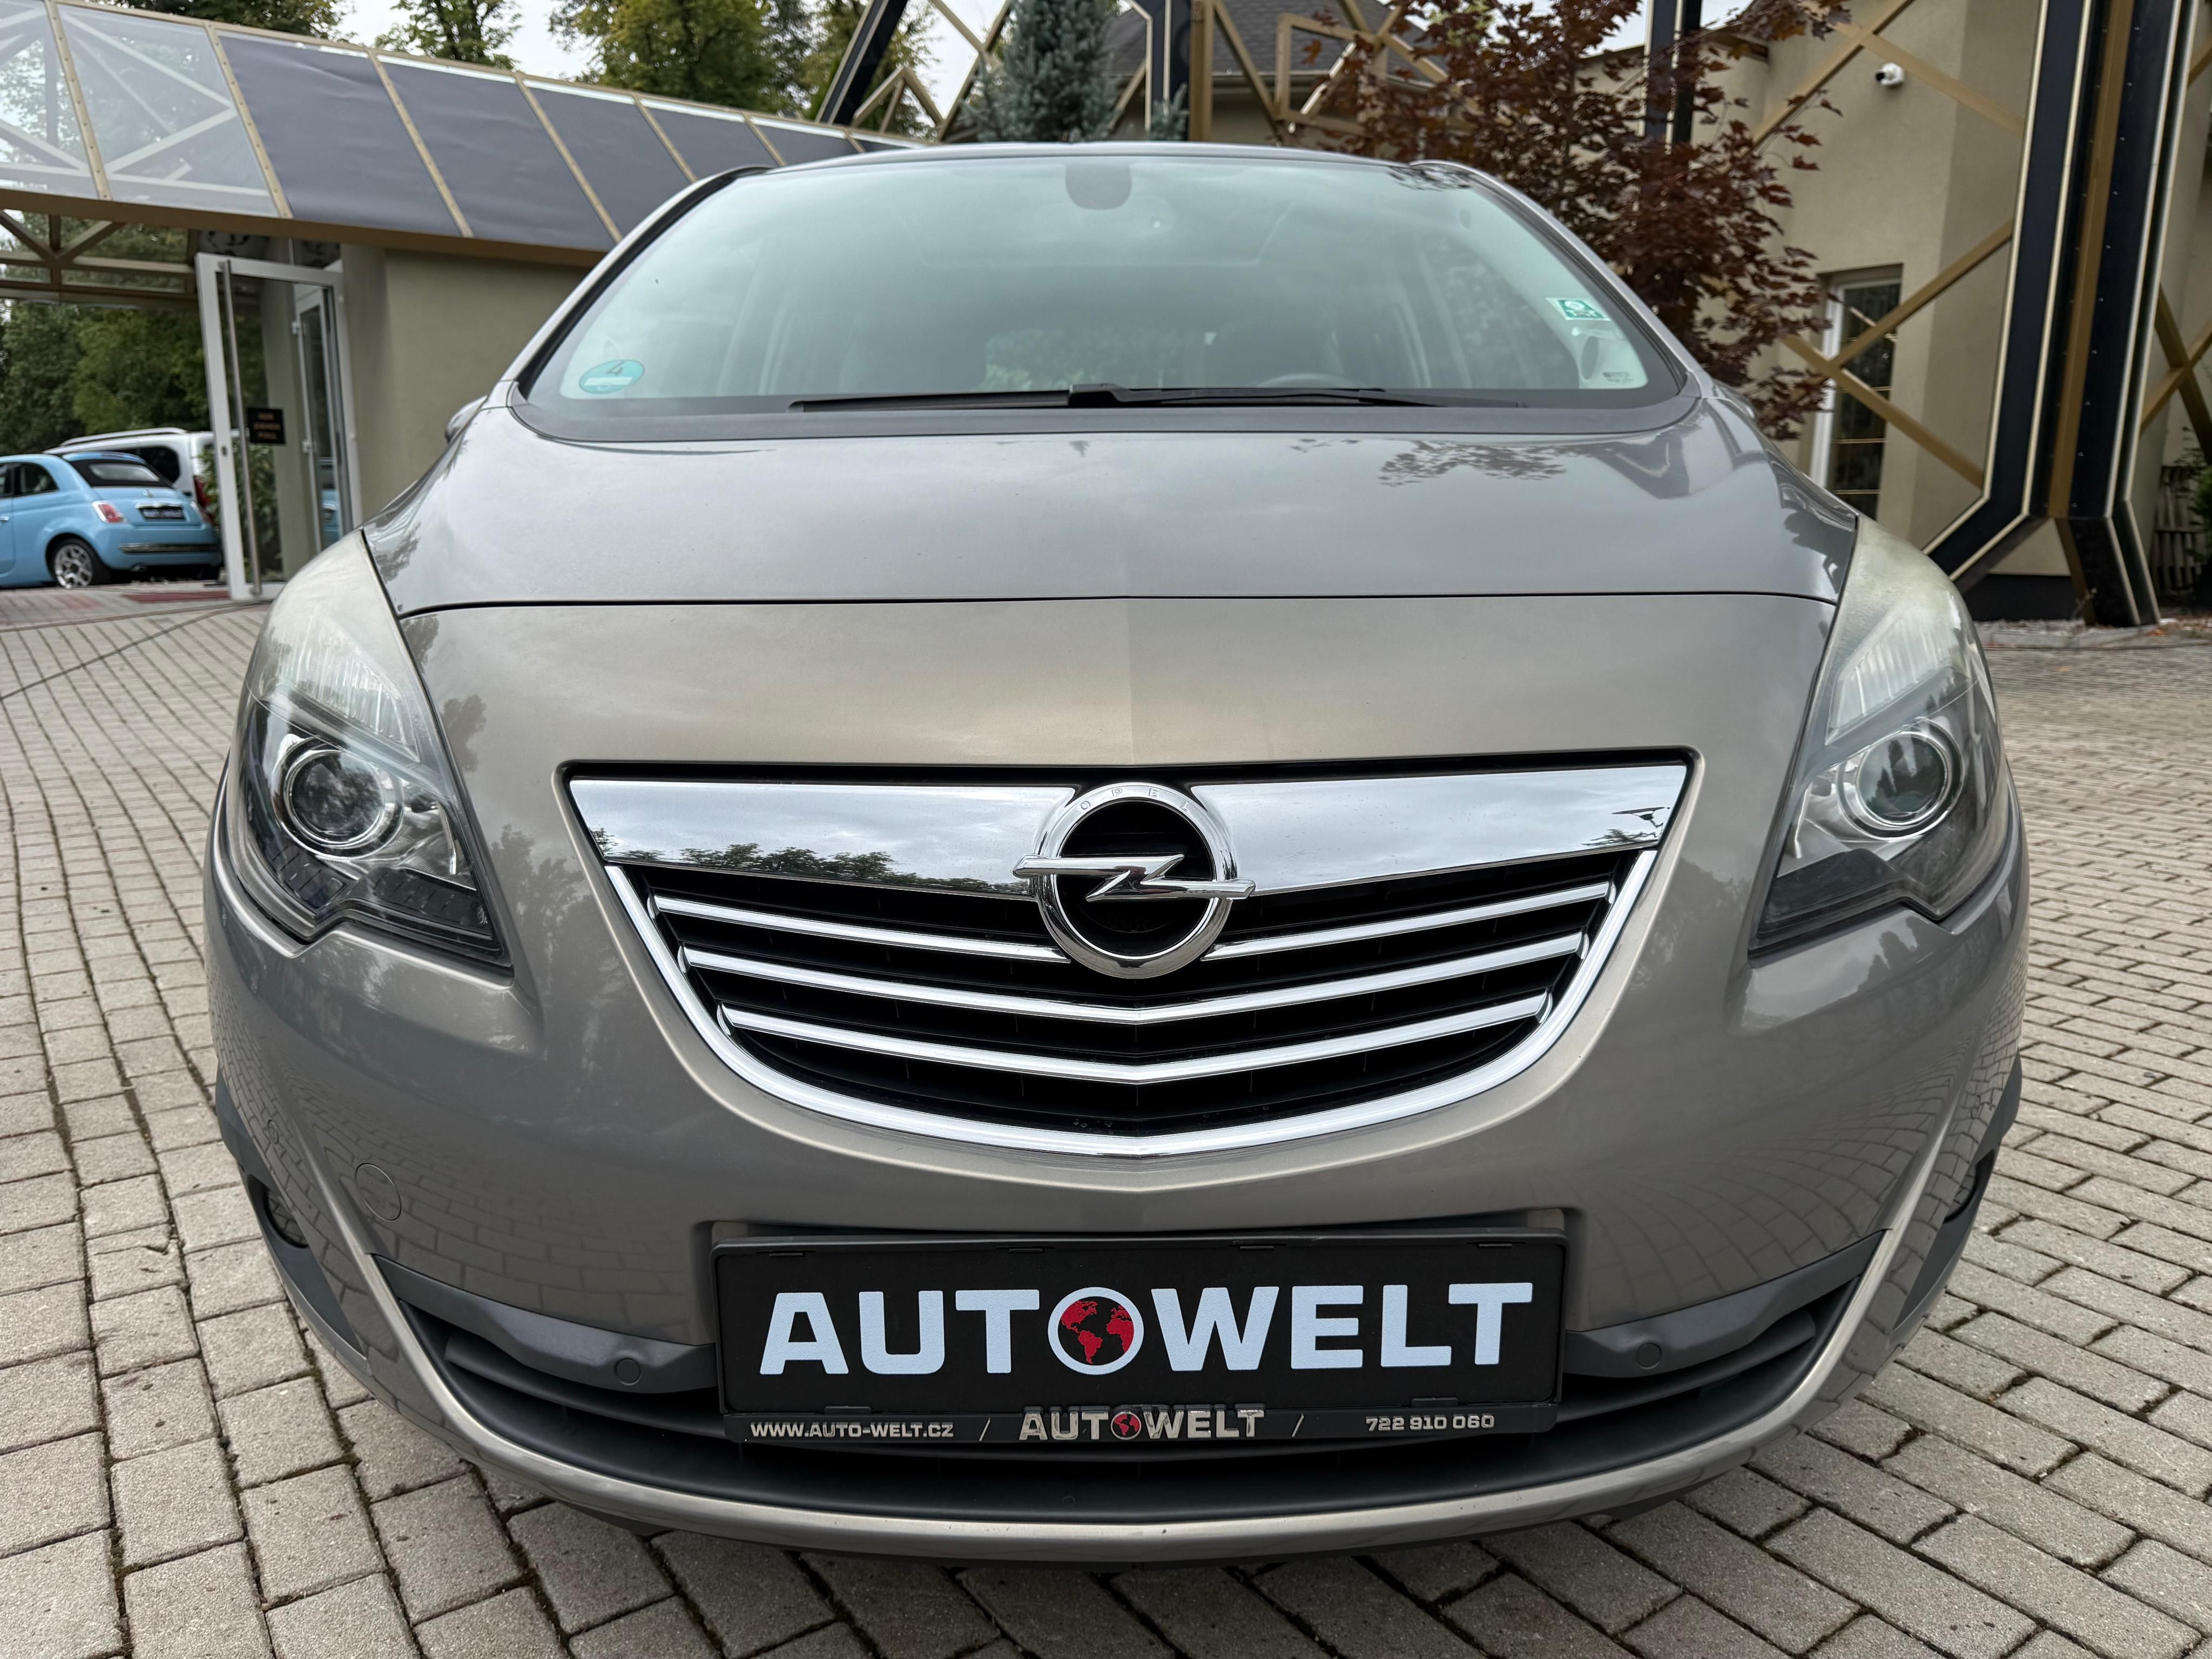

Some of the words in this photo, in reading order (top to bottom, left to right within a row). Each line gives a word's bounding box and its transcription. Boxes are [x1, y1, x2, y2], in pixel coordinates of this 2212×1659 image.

[1080, 788, 1189, 813] OPEL
[759, 1282, 1533, 1375] AUTOWELT
[750, 1421, 954, 1438] WWW.AUTO-WELT.CZ
[1019, 1407, 1265, 1441] AUTOWELT
[1365, 1417, 1405, 1432] 722
[1410, 1415, 1447, 1431] 910
[1452, 1414, 1495, 1429] 060
